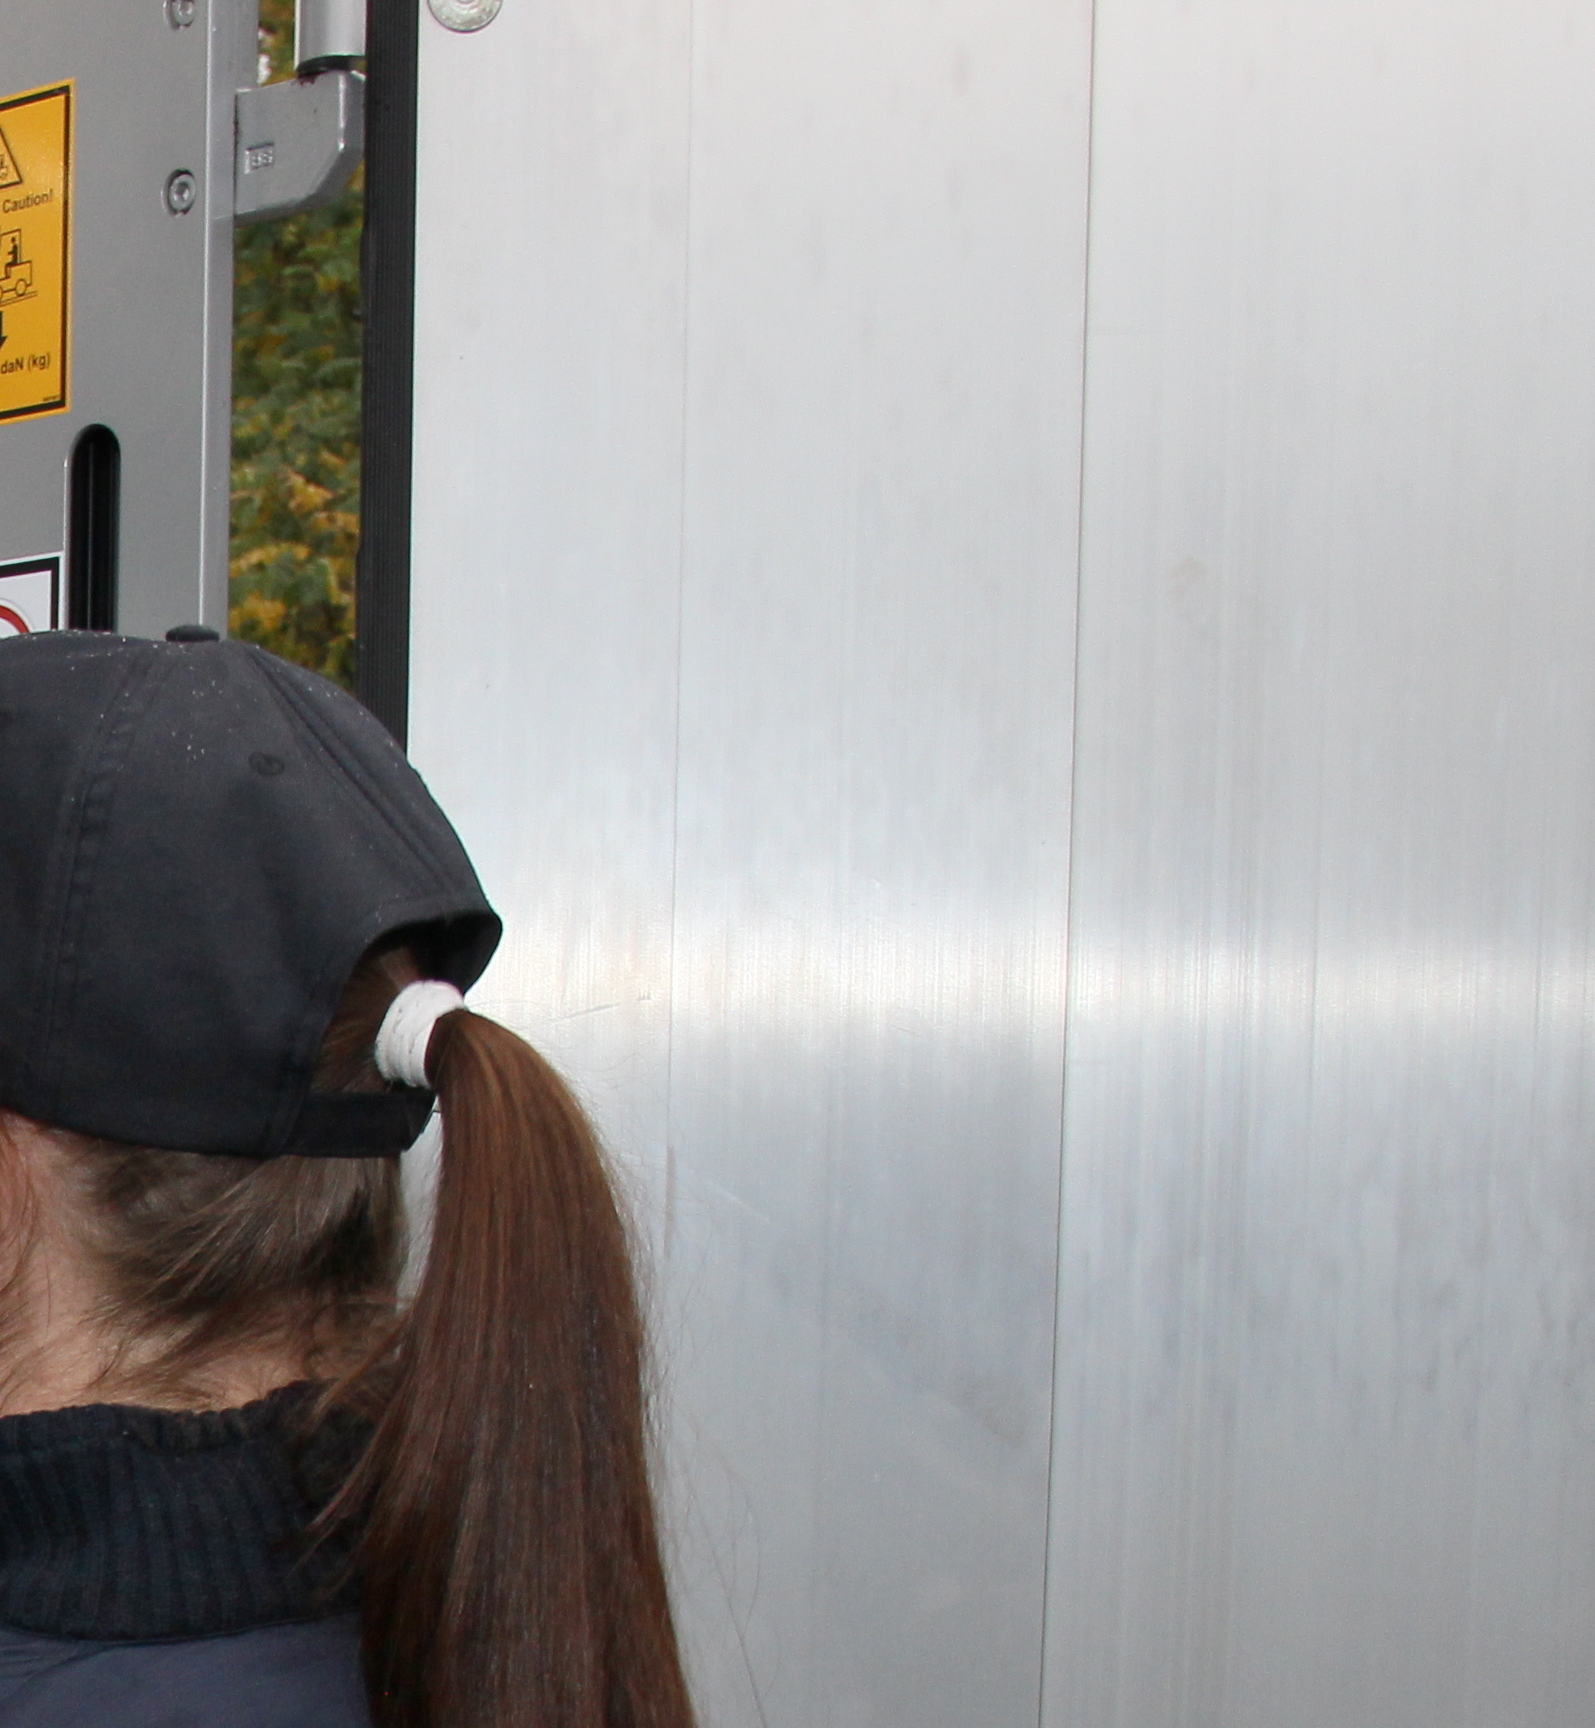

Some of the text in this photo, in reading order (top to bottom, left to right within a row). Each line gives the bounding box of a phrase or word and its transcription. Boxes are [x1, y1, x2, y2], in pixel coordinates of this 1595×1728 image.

[2, 188, 54, 214] Caution!
[0, 357, 25, 376] daN
[27, 352, 50, 371] (kg)
